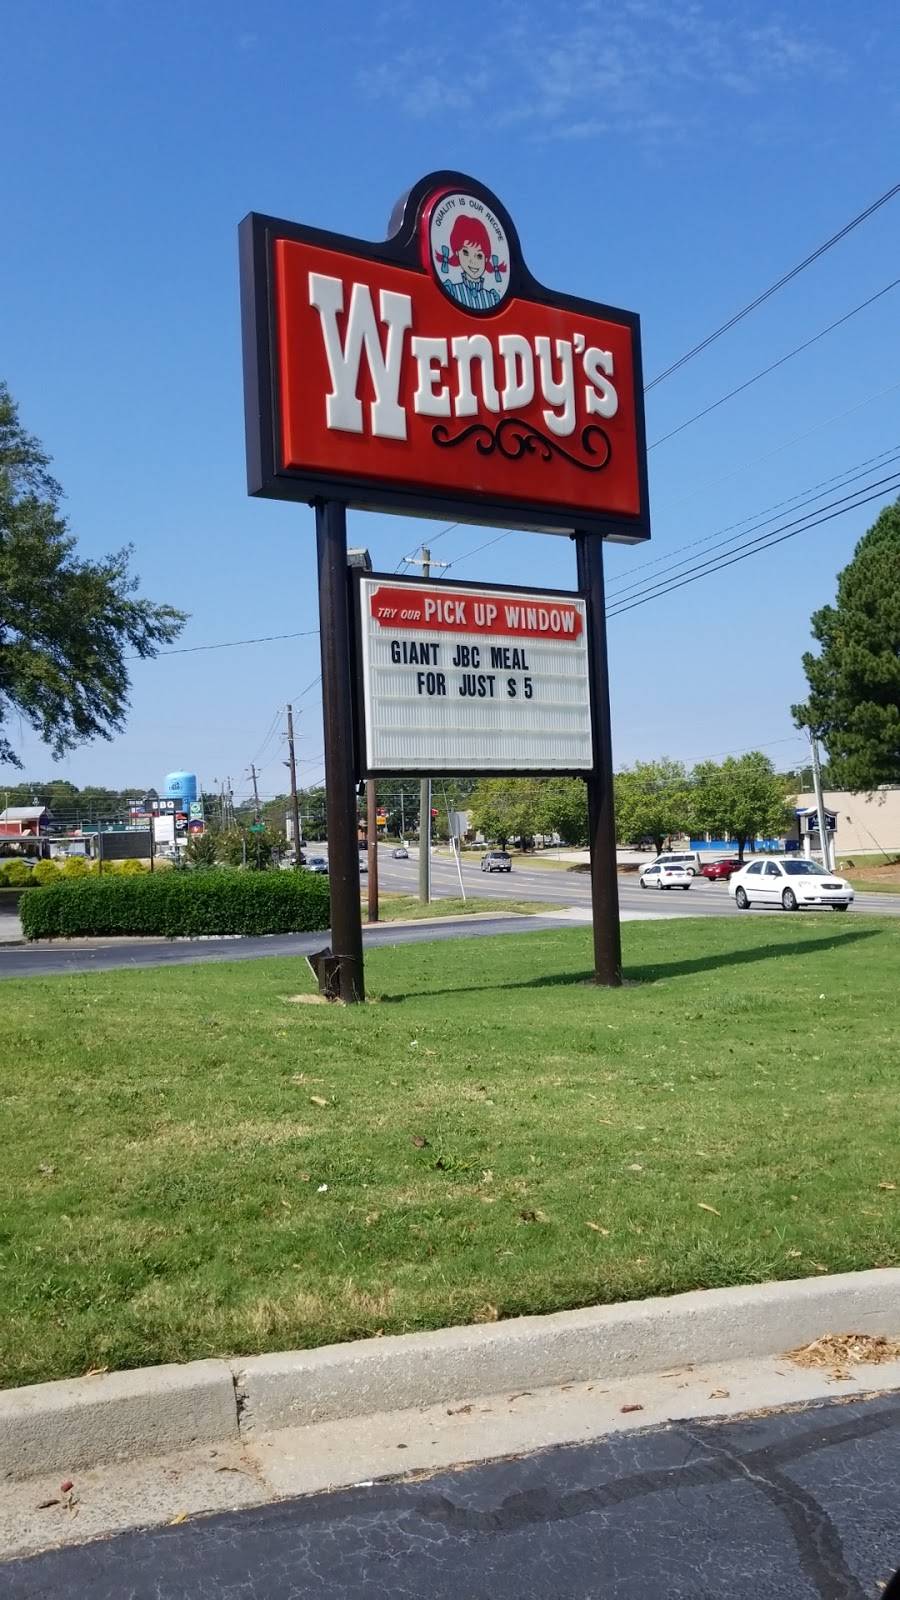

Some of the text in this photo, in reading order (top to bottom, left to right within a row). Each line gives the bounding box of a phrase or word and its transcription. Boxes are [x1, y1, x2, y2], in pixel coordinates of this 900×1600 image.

[435, 198, 504, 242] QUALITY IS OUR RECIPE
[377, 599, 575, 633] TRY OUR PICK UP WINDOW
[391, 640, 529, 671] GIANT JBC MEAL
[417, 672, 446, 696] FOR
[459, 674, 496, 697] JUST
